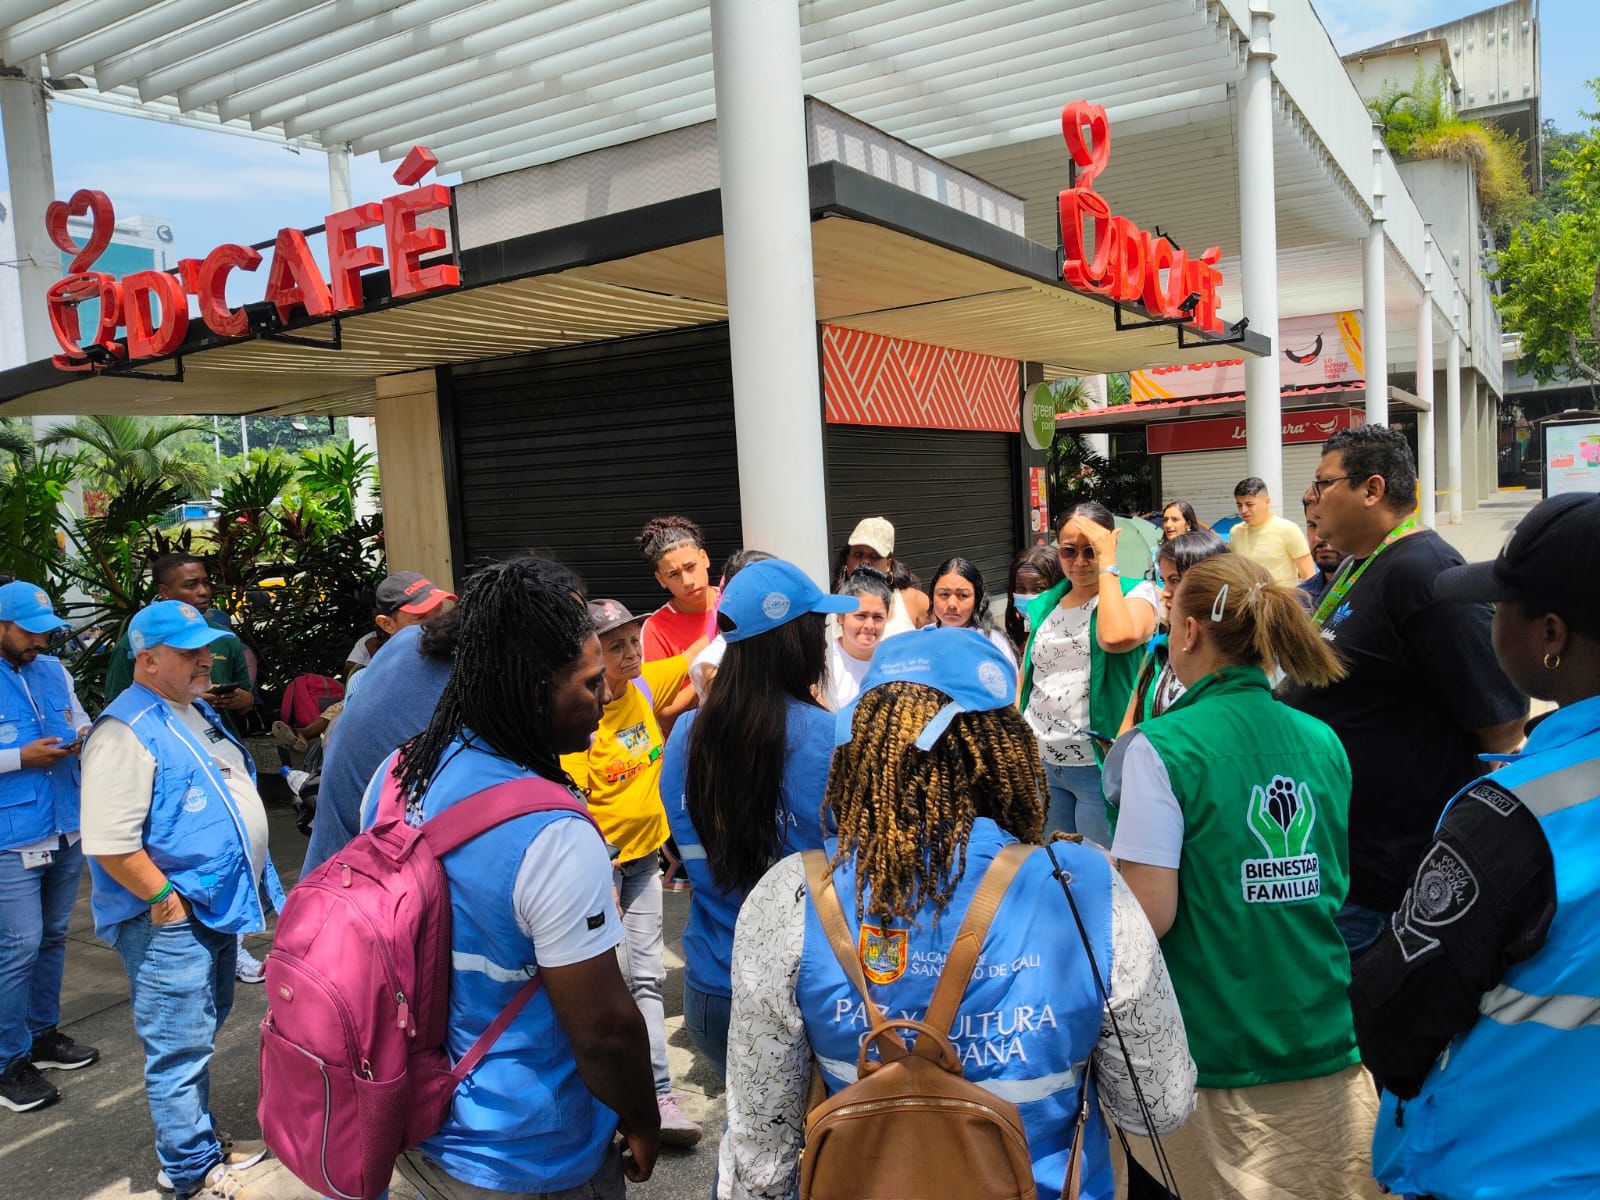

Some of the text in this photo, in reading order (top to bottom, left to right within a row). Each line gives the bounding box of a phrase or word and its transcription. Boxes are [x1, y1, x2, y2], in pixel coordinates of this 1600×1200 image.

[1032, 404, 1054, 421] green
[1245, 857, 1318, 879] BIENESTAR
[1246, 879, 1320, 902] FAMILIAR
[1429, 858, 1465, 906] NACIONAL
[989, 964, 1007, 978] DE
[1011, 953, 1040, 973] CALI
[948, 1004, 1058, 1040] ULTURA
